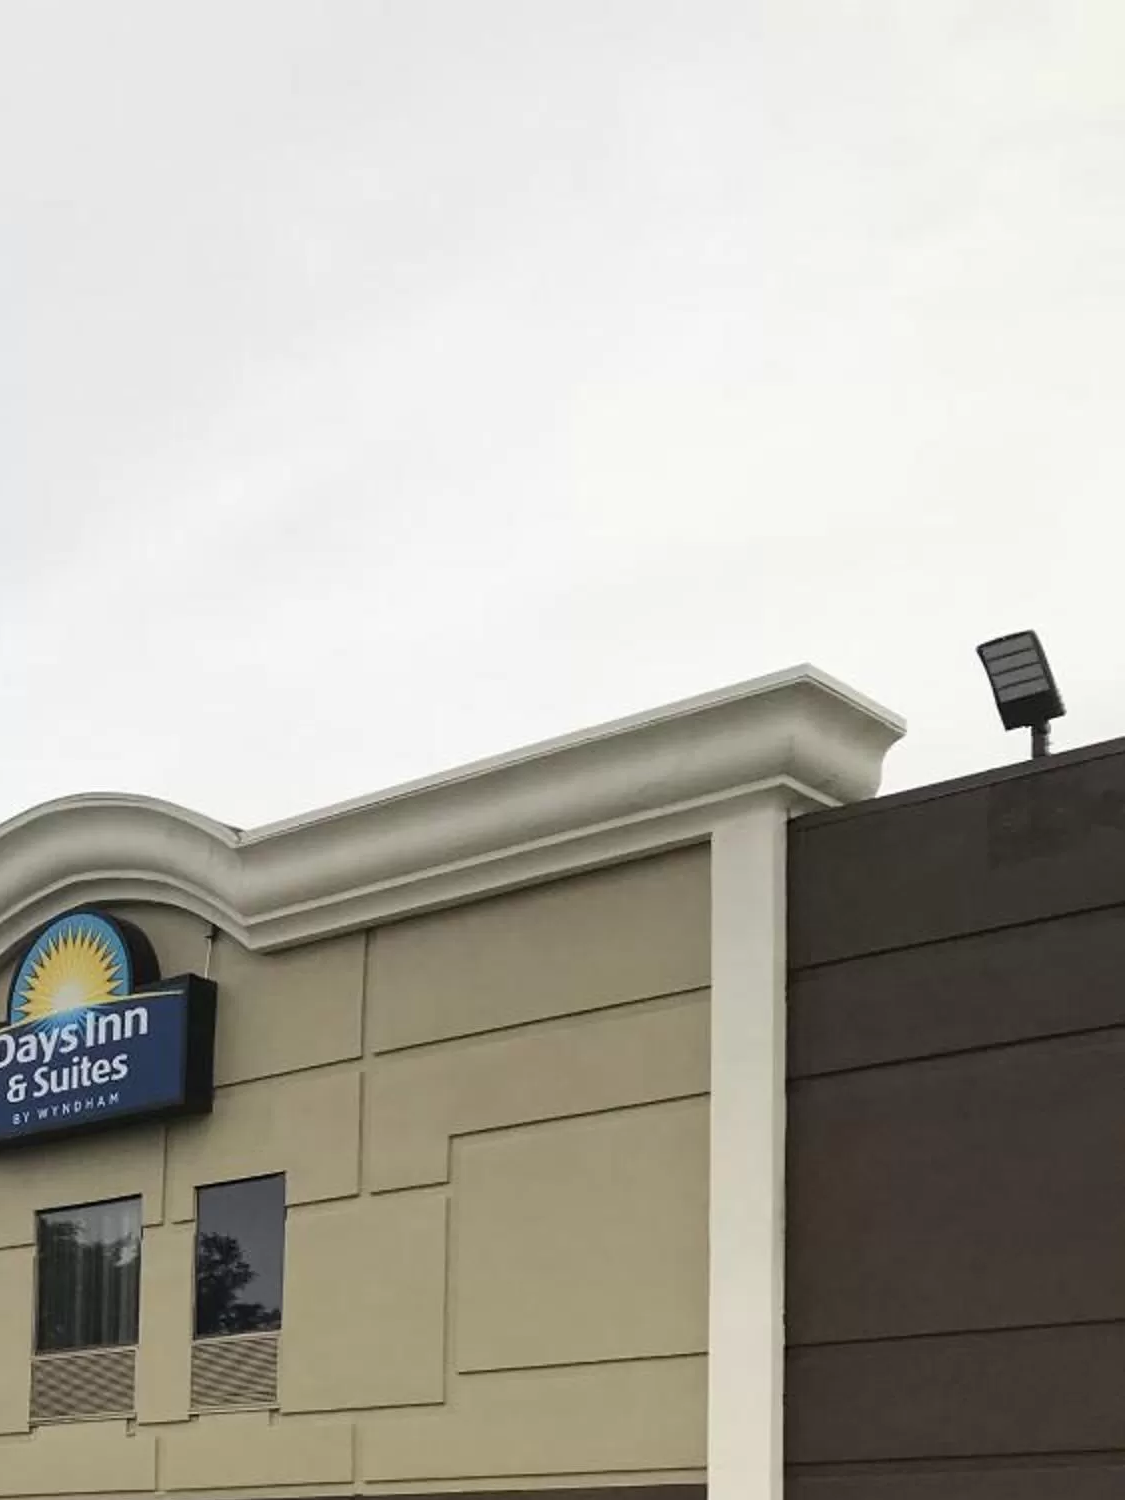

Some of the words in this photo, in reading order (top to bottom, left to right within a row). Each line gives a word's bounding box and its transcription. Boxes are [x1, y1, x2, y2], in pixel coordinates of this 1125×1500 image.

[86, 1007, 148, 1047] Inn
[7, 1075, 27, 1103] &
[33, 1054, 128, 1098] Suites
[13, 1110, 30, 1125] BY
[38, 1093, 119, 1120] WYNDHAM
